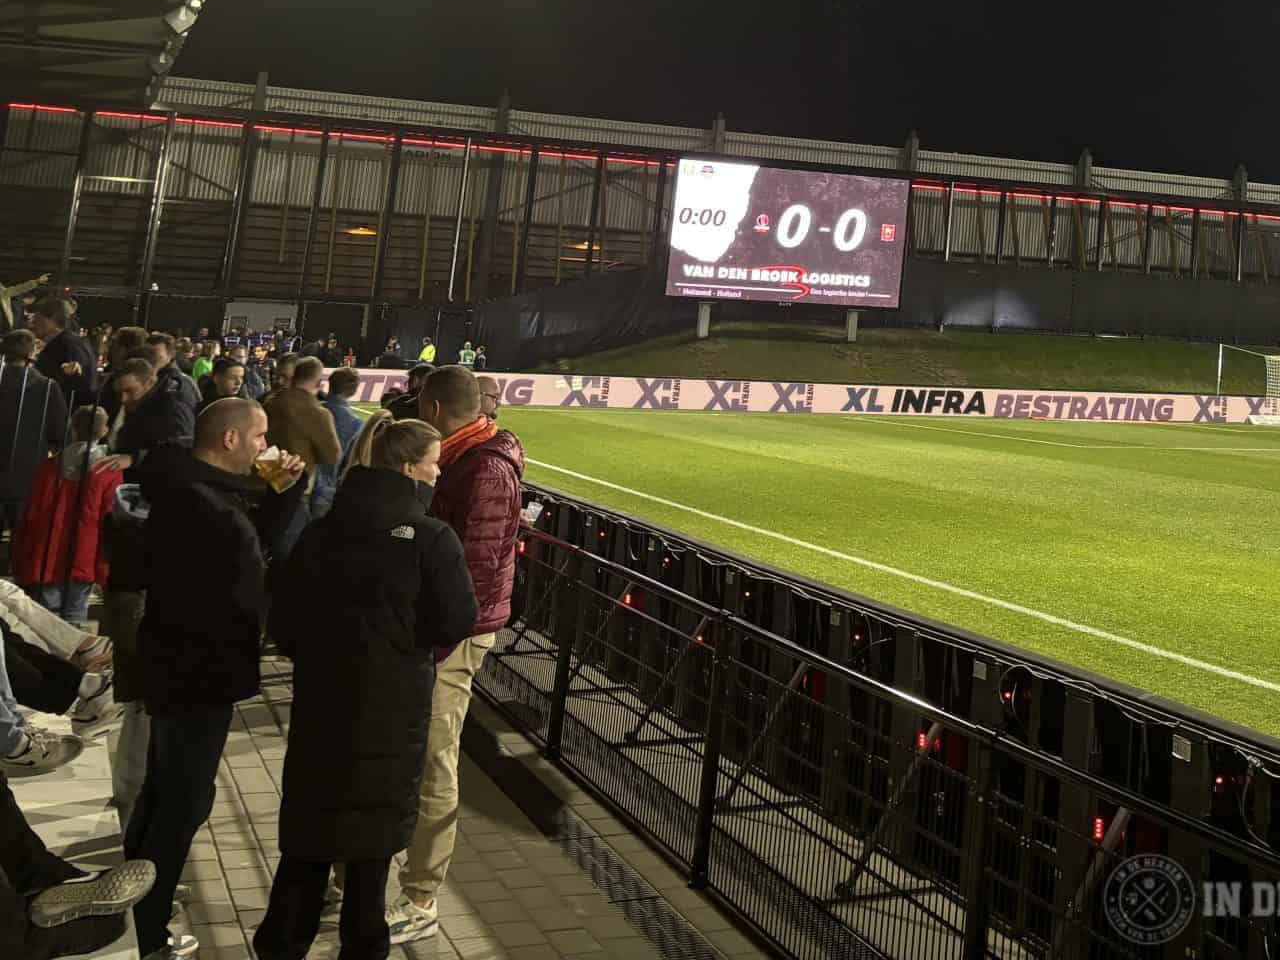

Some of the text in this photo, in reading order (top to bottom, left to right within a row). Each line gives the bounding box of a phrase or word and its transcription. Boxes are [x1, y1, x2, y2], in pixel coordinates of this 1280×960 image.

[679, 207, 726, 226] 0:00
[777, 204, 812, 248] 0
[834, 208, 867, 252] 0
[683, 264, 714, 279] VAN
[718, 267, 747, 281] DEN
[801, 272, 870, 288] LOGISTICS
[840, 387, 1174, 422] XL INFRA BESTRATING
